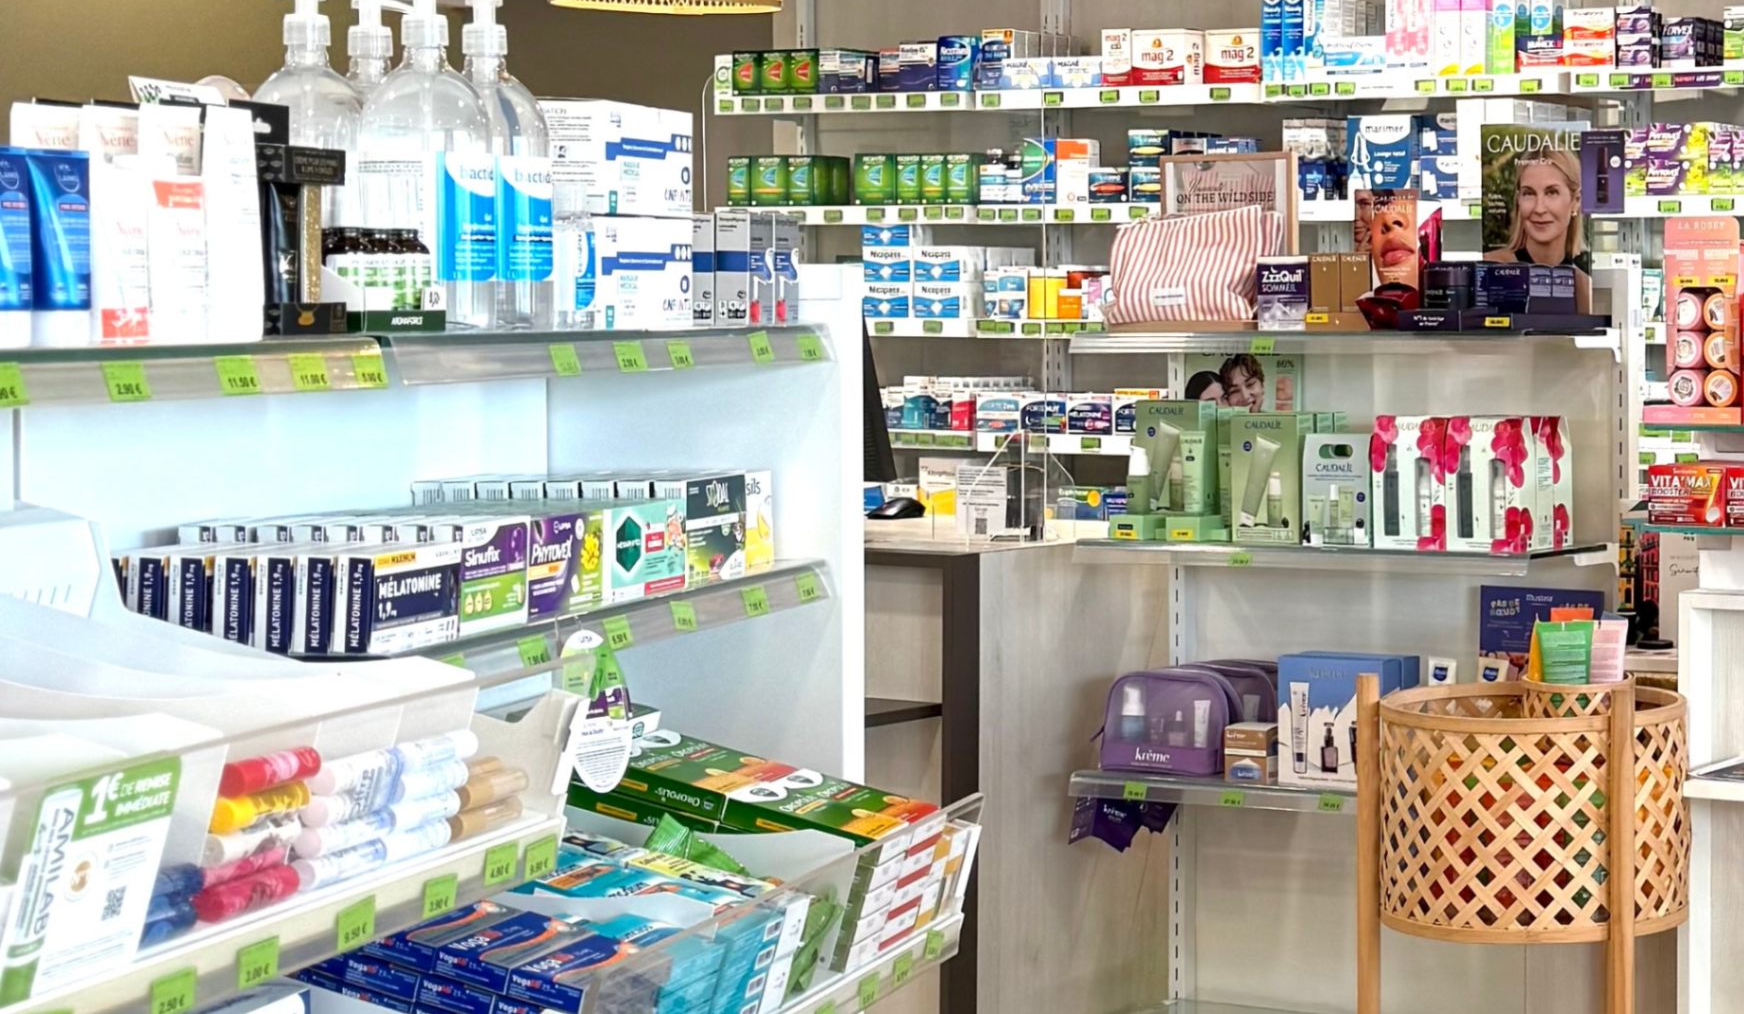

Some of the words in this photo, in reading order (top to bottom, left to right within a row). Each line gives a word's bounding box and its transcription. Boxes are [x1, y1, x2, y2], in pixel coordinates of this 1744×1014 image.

[1141, 52, 1164, 64] mag
[1166, 49, 1174, 61] 2
[1221, 49, 1245, 63] mag
[1246, 47, 1254, 59] 2
[1176, 193, 1191, 204] ON
[1195, 192, 1215, 204] THE
[1248, 191, 1274, 203] SIDE
[379, 573, 442, 599] MÉLATONINE
[135, 773, 172, 792] REMISE
[114, 790, 171, 817] IMMÉDIATE
